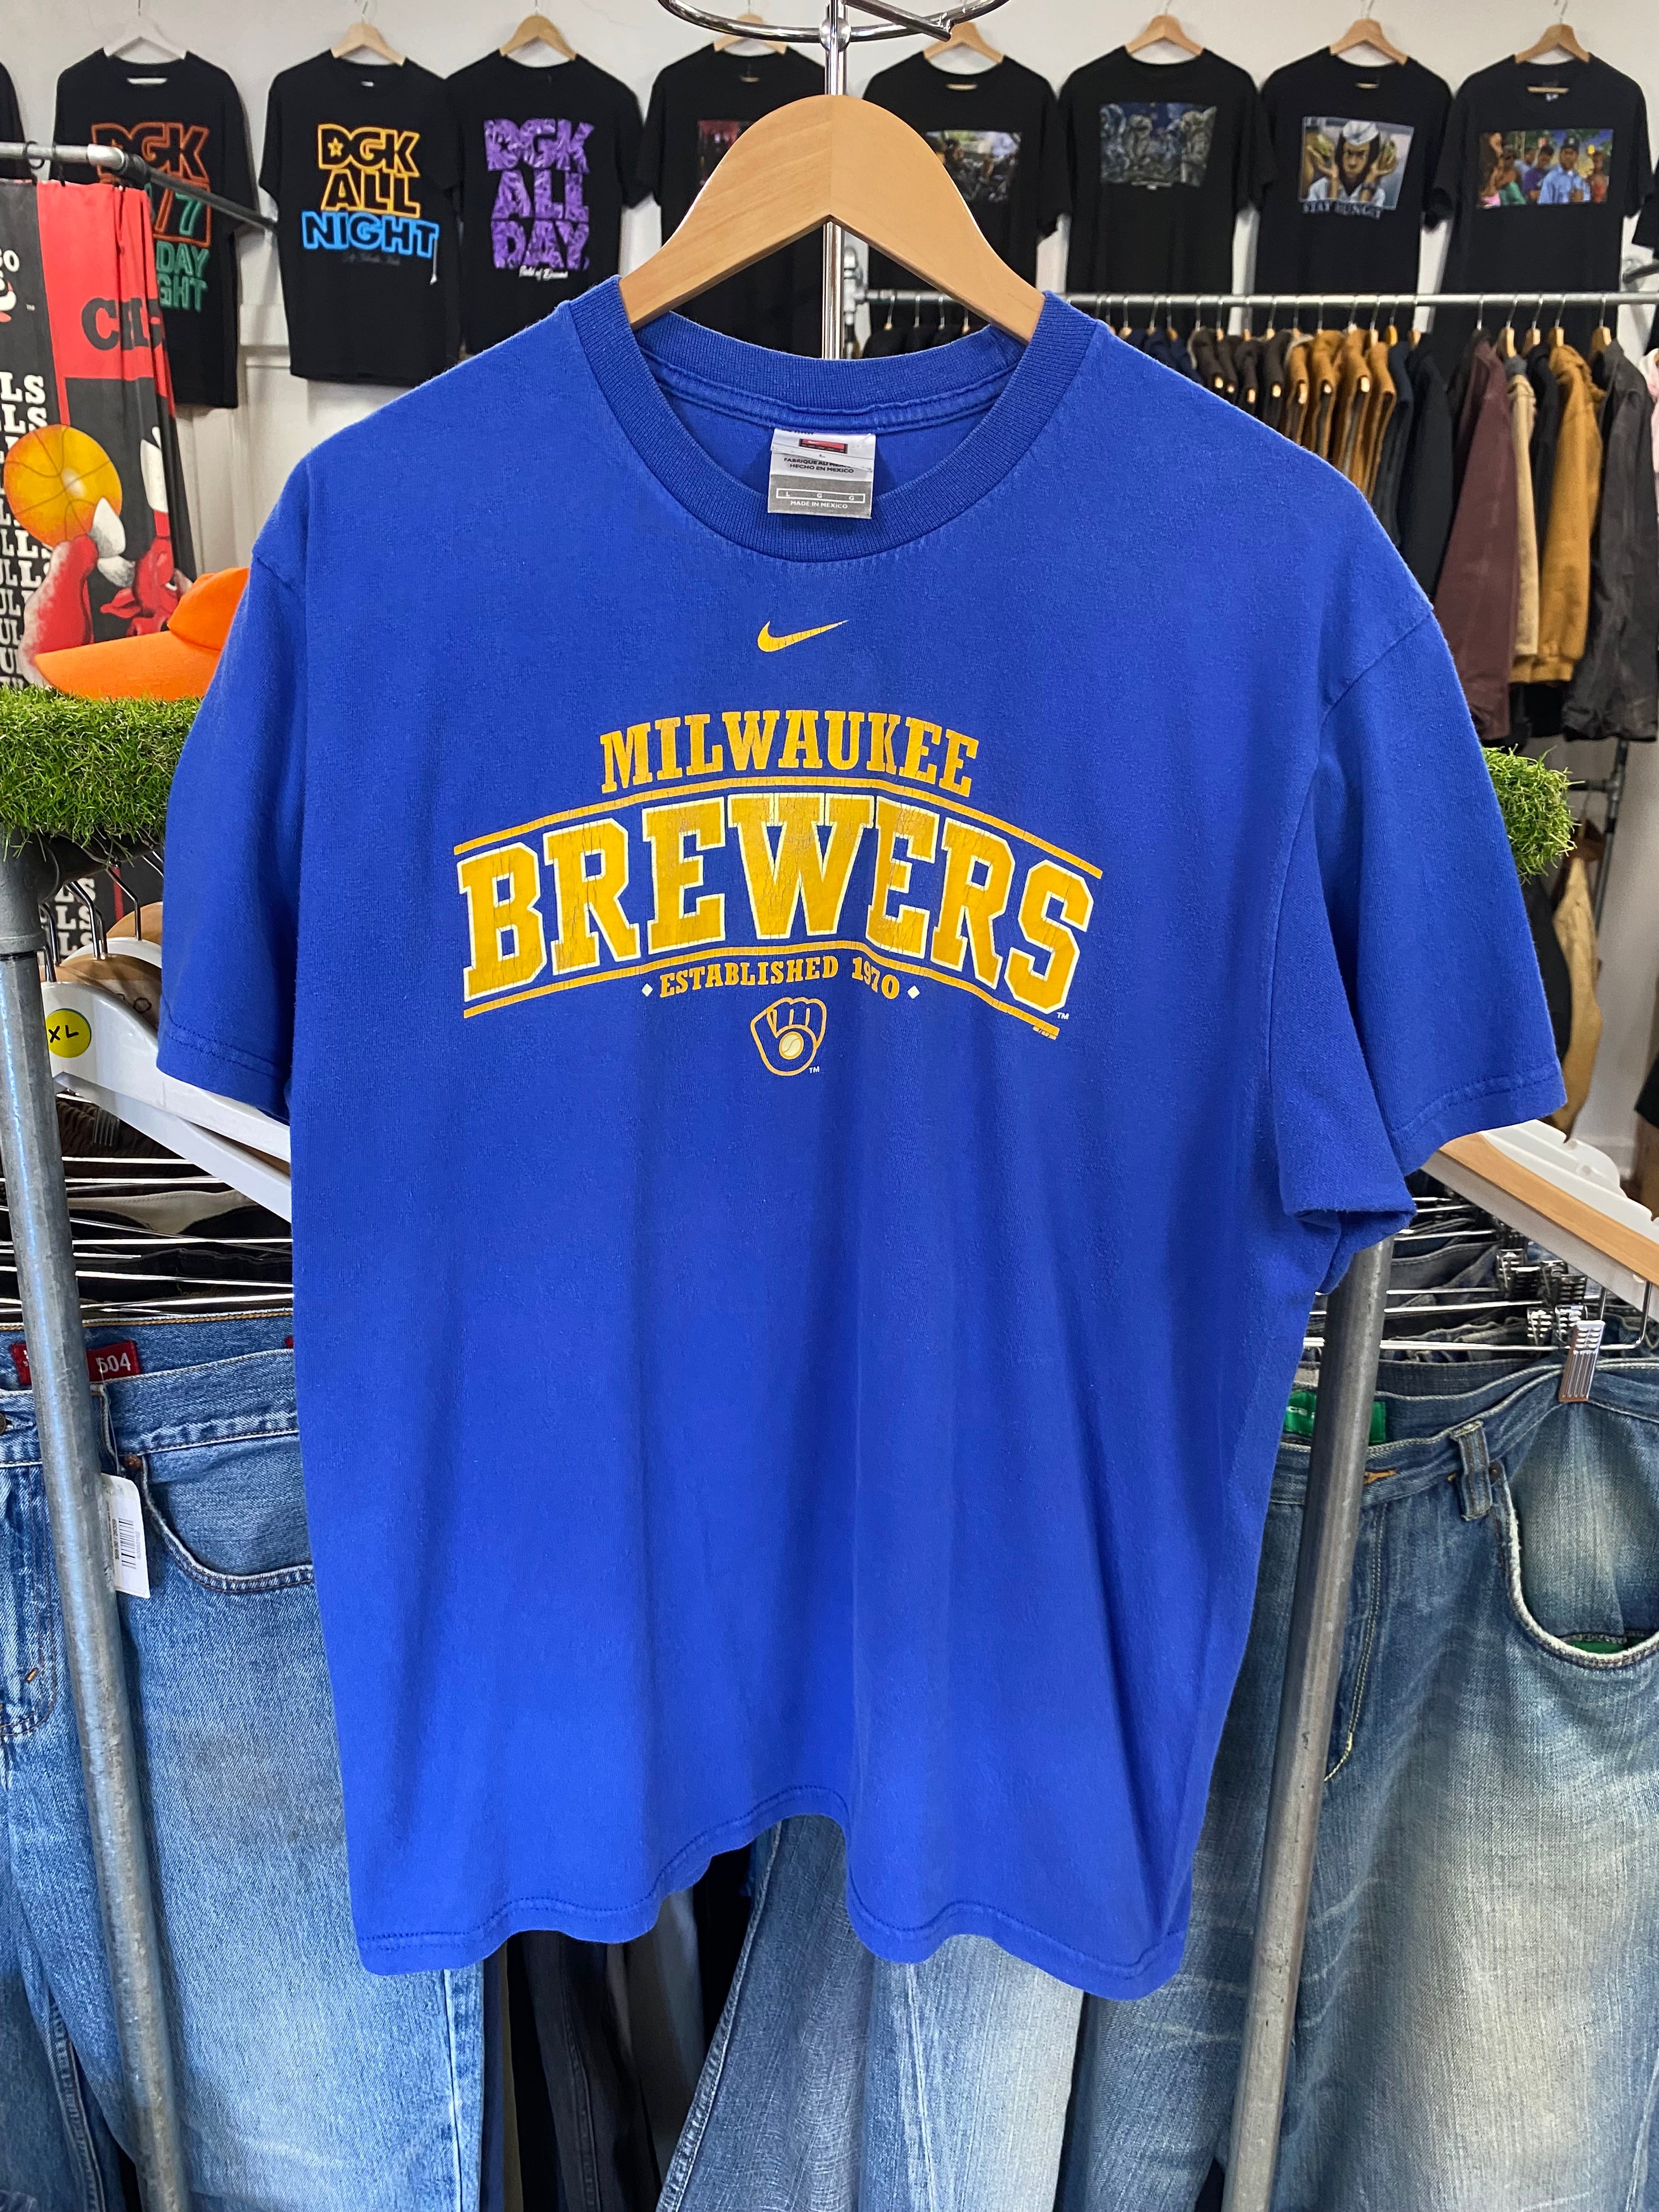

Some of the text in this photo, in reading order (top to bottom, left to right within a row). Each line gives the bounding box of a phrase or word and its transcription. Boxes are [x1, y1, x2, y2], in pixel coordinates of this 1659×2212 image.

[317, 123, 420, 178] DGK
[483, 118, 595, 174] DGK
[321, 168, 420, 218] ALL
[491, 169, 590, 222] ALL
[302, 211, 440, 258] NIGHT
[491, 221, 590, 271] DAY
[156, 241, 211, 277] DAY
[158, 273, 208, 312] GHT
[784, 457, 817, 466] FABRIQUE
[600, 709, 979, 797] MILWAUKEE
[457, 792, 1095, 1014] BREWERS
[659, 955, 900, 1000] ESTABLISHED 1970
[48, 1024, 79, 1044] XL
[1056, 1011, 1070, 1020] TM
[808, 1066, 820, 1074] TM
